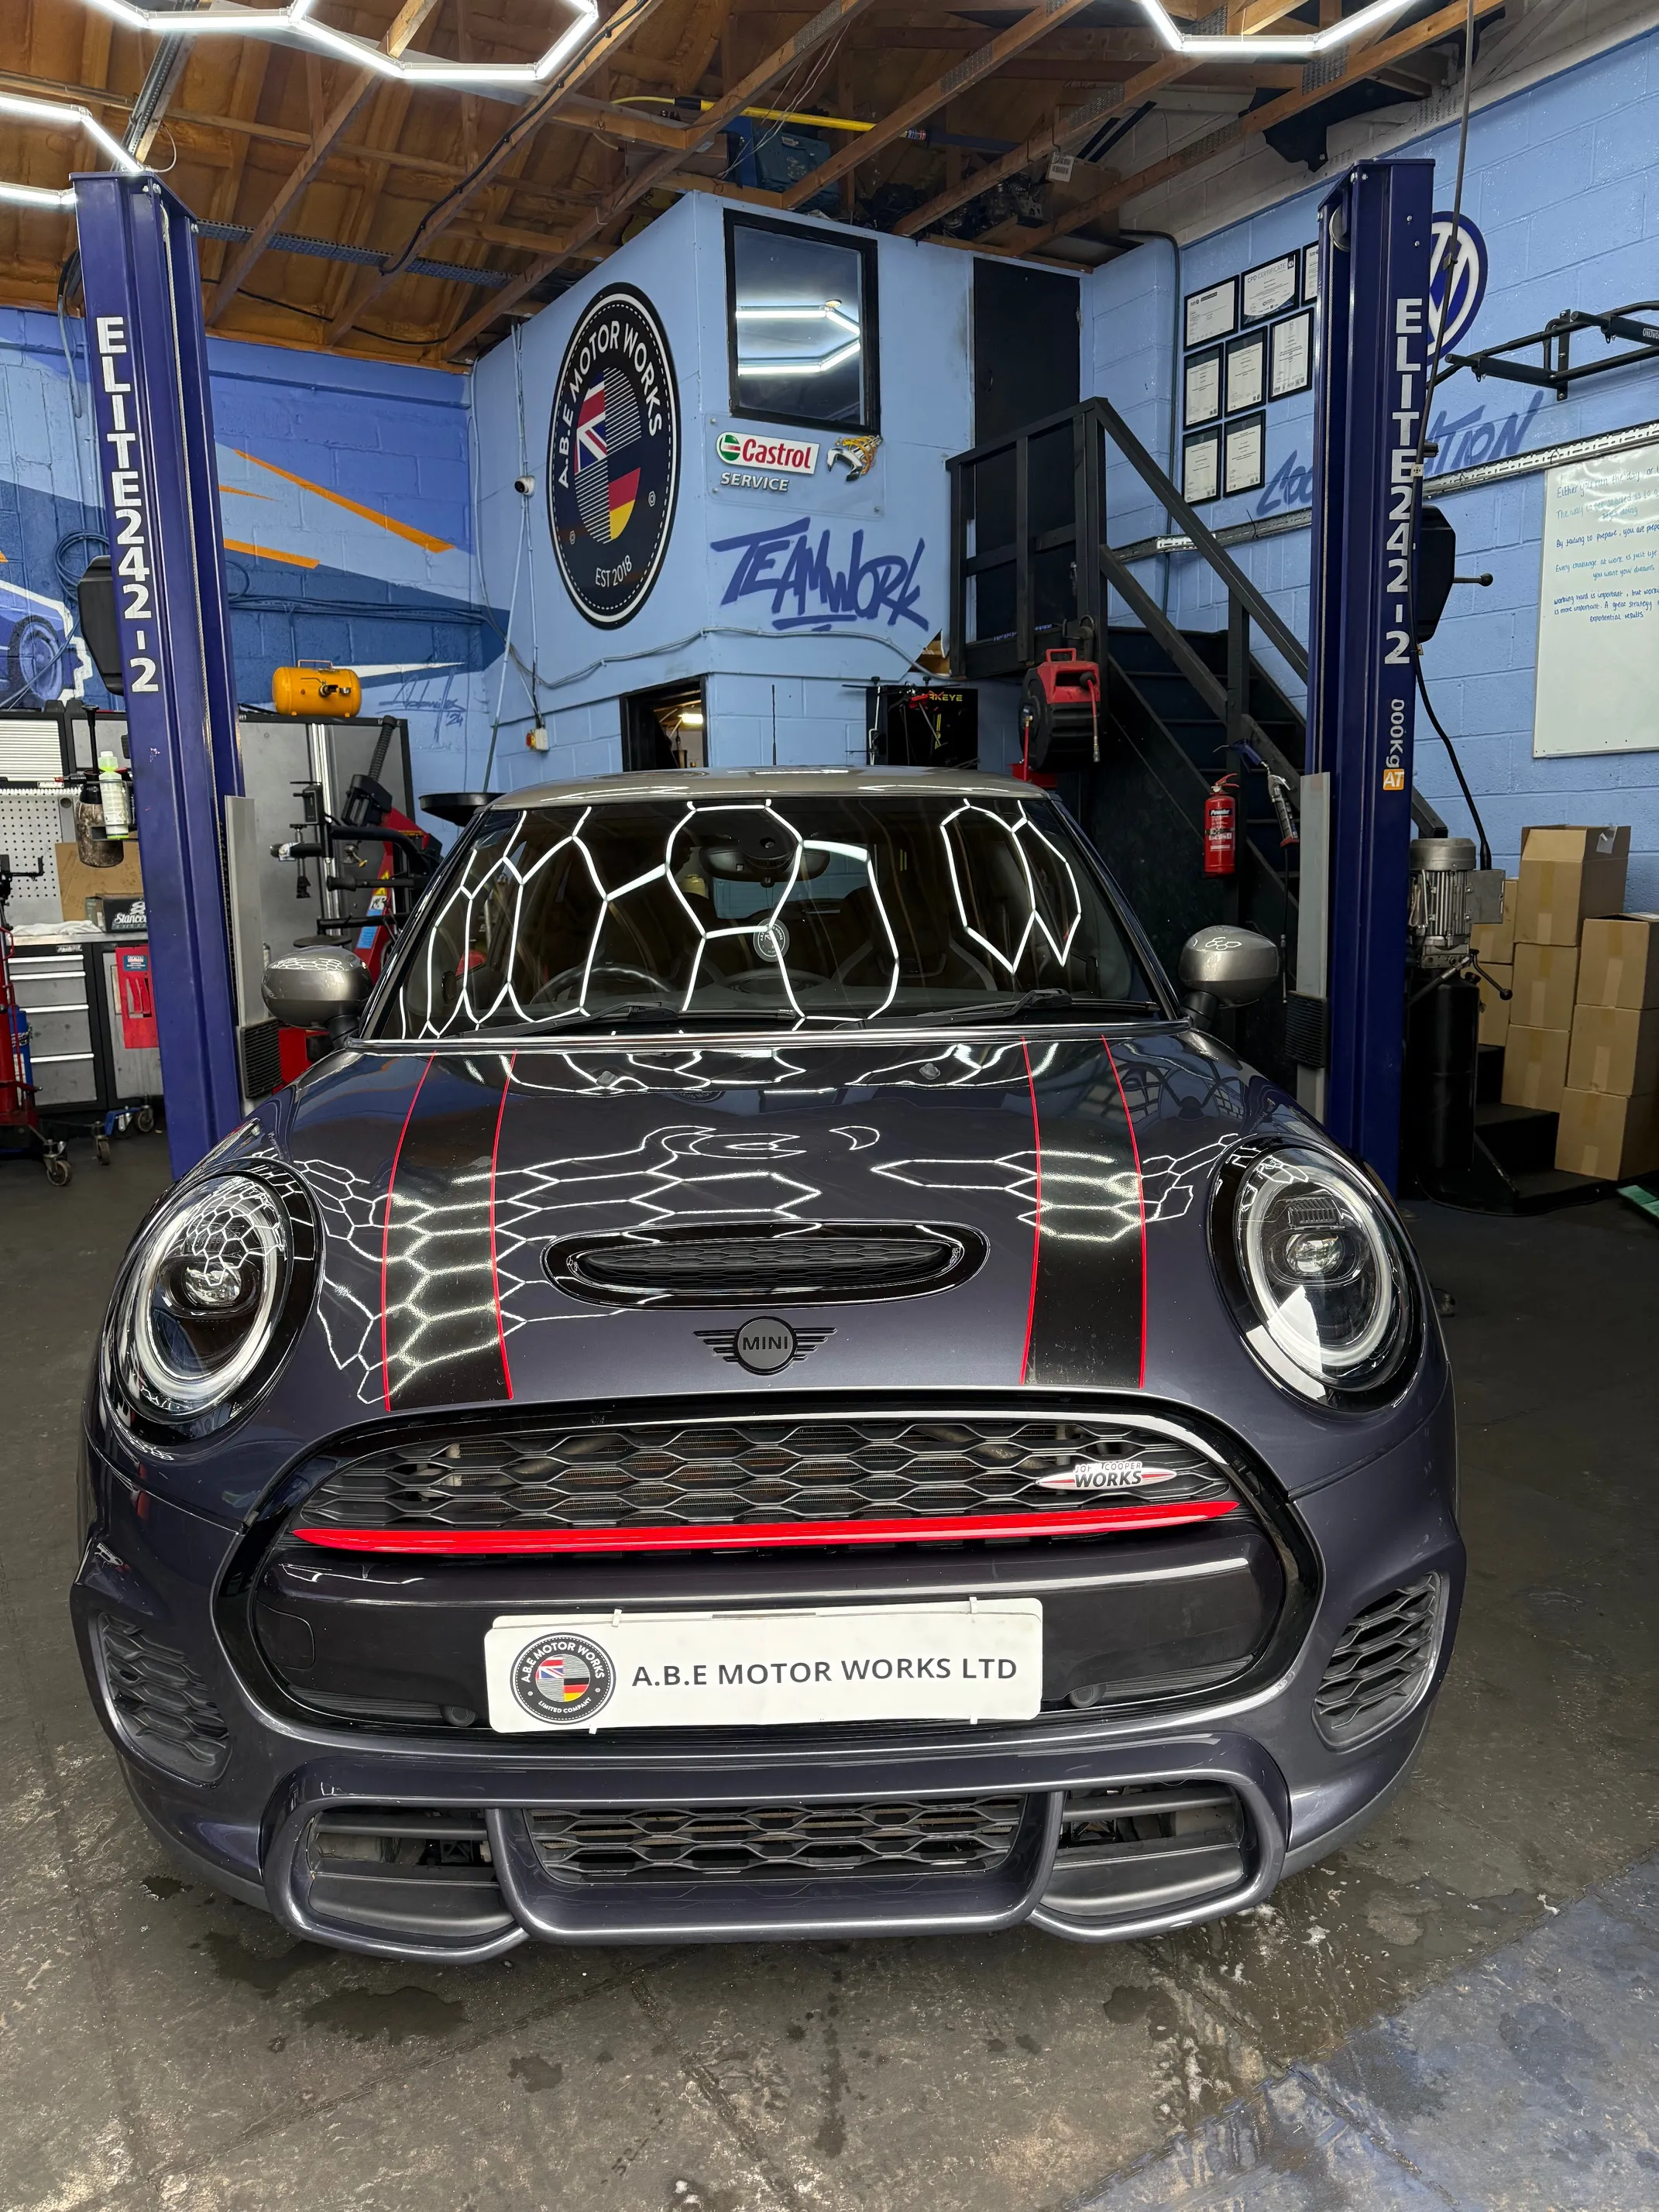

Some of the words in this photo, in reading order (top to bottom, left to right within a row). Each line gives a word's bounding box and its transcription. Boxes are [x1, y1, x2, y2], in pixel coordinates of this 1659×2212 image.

[558, 407, 575, 489] A.B.E
[569, 320, 620, 403] MOTOR
[623, 321, 663, 437] WORKS
[742, 438, 811, 469] Castrol
[720, 472, 790, 492] SERVICE
[1557, 485, 1578, 498] Either
[1647, 467, 1654, 476] or
[1556, 539, 1564, 548] By
[1623, 527, 1635, 538] you
[595, 566, 611, 589] EST
[612, 554, 633, 587] 2018
[1555, 564, 1571, 573] Every
[1572, 559, 1597, 569] challenge
[1633, 551, 1646, 561] just
[1647, 549, 1657, 558] life
[709, 516, 930, 633] TEAMWORK
[1592, 572, 1603, 581] you
[1620, 567, 1633, 577] your
[1633, 564, 1655, 573] dreams
[1613, 601, 1626, 611] great
[1629, 600, 1652, 611] strategy
[1589, 613, 1622, 623] exponential
[1624, 610, 1644, 620] results
[742, 1335, 788, 1351] MINI
[1104, 1462, 1142, 1471] COOPER
[1075, 1470, 1142, 1488] WORKS
[520, 1657, 537, 1684] A.B.E
[532, 1641, 576, 1661] MOTOR
[577, 1644, 606, 1679] WORKS
[631, 1664, 707, 1687] A.B.E
[718, 1661, 833, 1685] MOTOR
[841, 1657, 951, 1681] WORKS
[962, 1657, 1018, 1679] LTD
[538, 1700, 562, 1713] LIMITED
[562, 1696, 592, 1713] COMPANY
